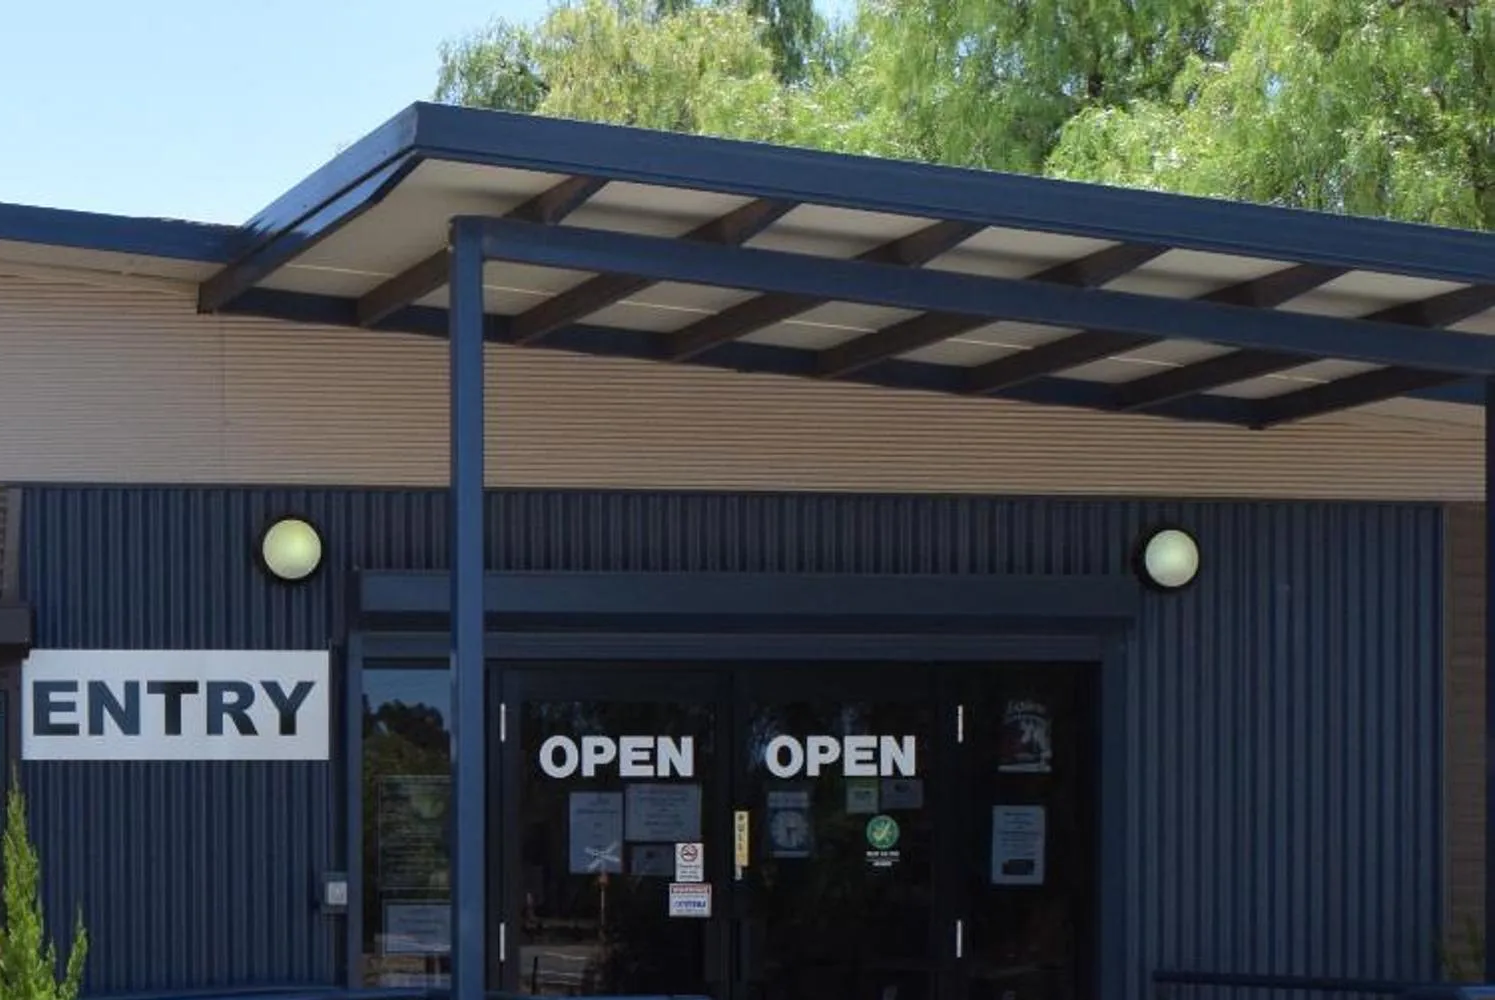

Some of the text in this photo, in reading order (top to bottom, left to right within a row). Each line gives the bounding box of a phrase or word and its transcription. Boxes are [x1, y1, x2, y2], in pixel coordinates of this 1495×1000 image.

[33, 680, 316, 736] ENTRY
[539, 735, 693, 778] OPEN
[765, 735, 916, 777] OPEN
